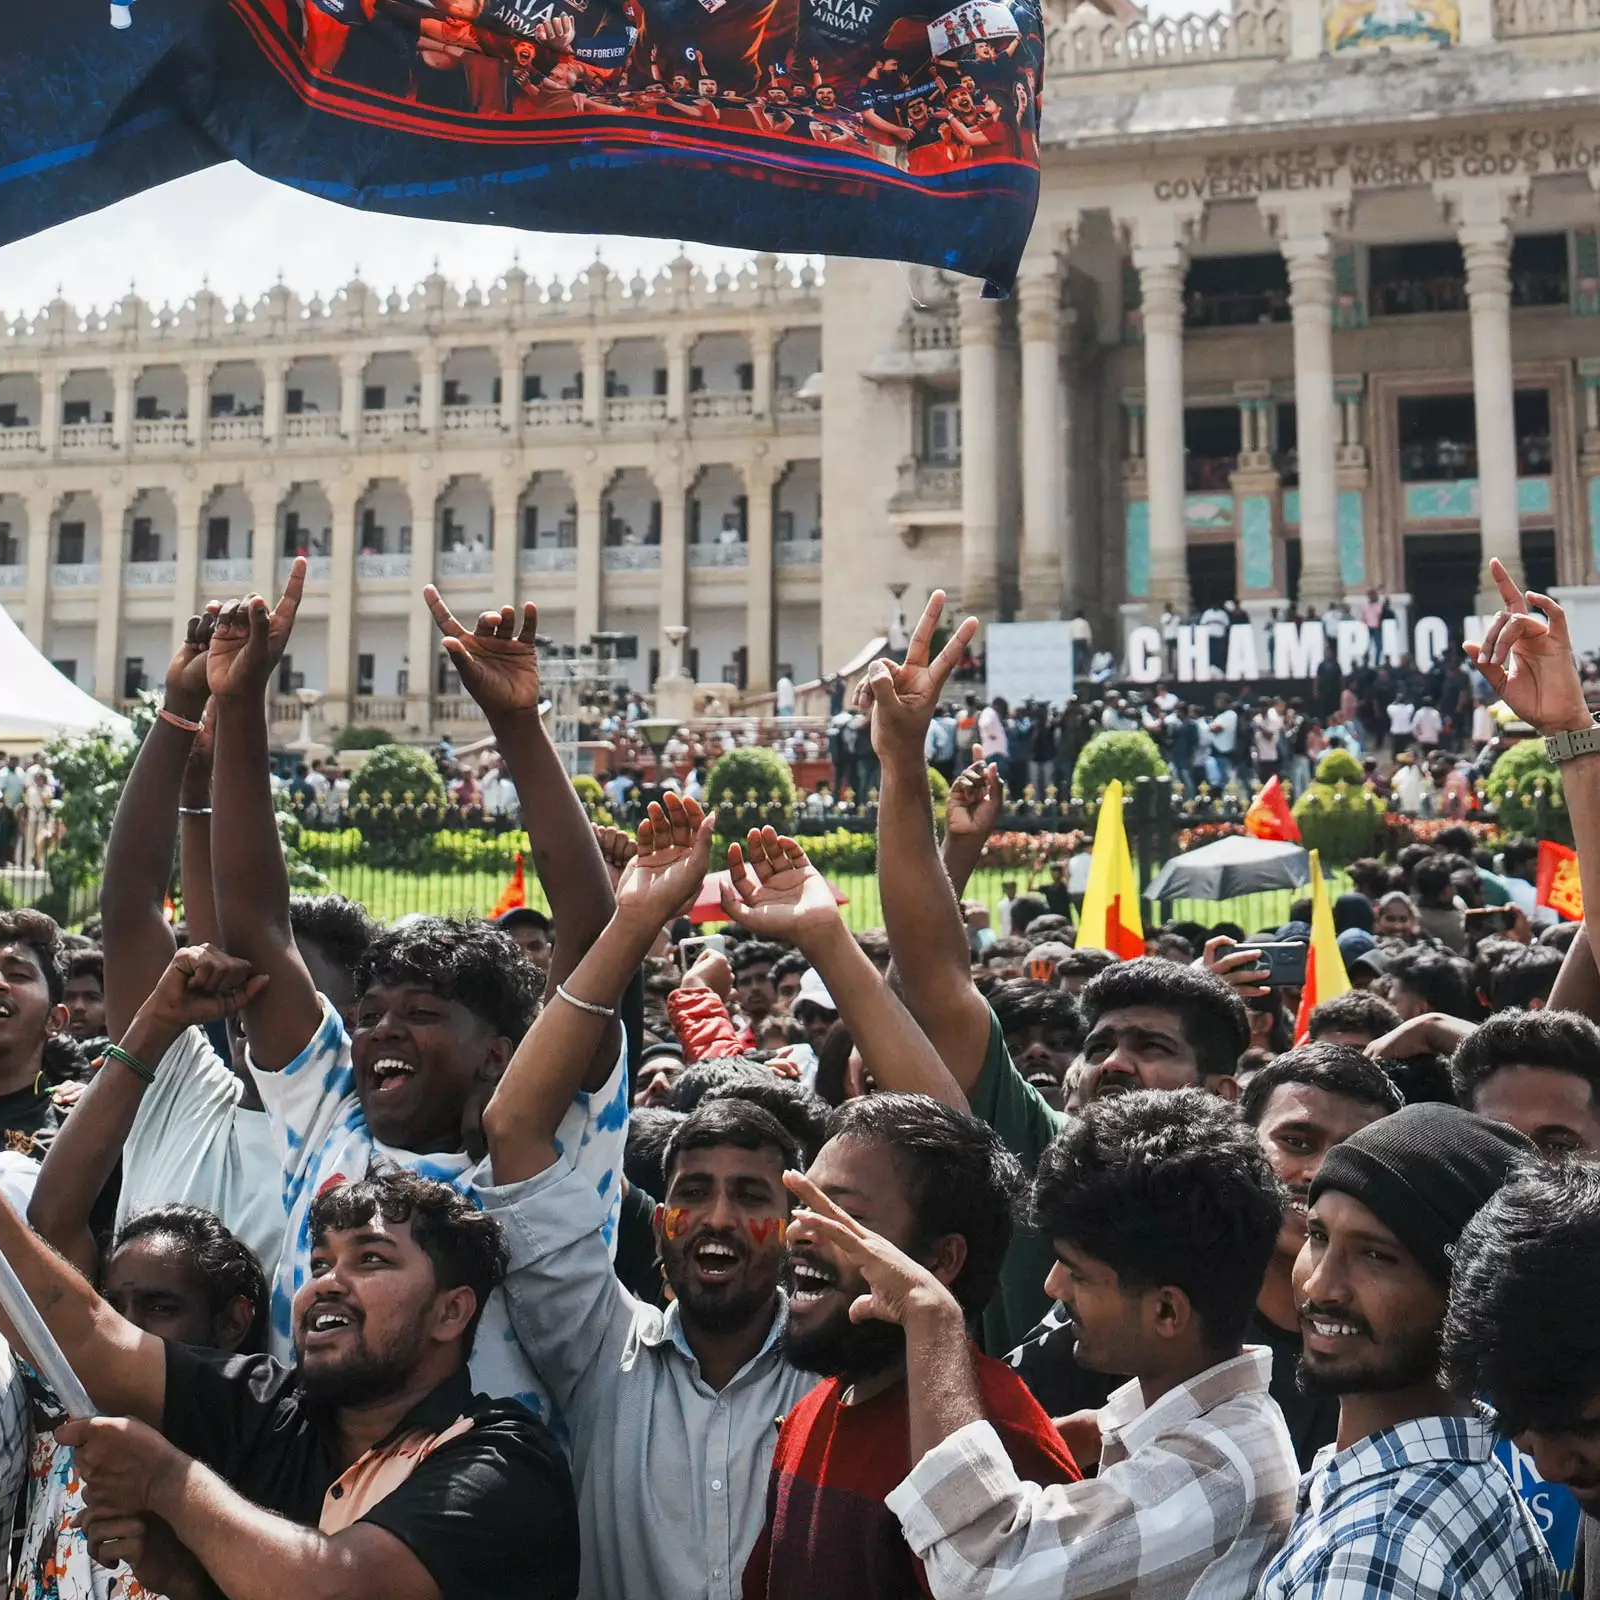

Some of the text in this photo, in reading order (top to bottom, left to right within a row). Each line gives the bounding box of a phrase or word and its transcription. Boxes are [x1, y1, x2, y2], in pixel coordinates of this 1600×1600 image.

[494, 5, 537, 39] AIRW
[593, 46, 625, 59] FOREVER!
[685, 47, 696, 61] 6
[1154, 167, 1338, 201] GOVERNMENT
[1351, 159, 1422, 185] WORK
[1431, 157, 1454, 181] IS
